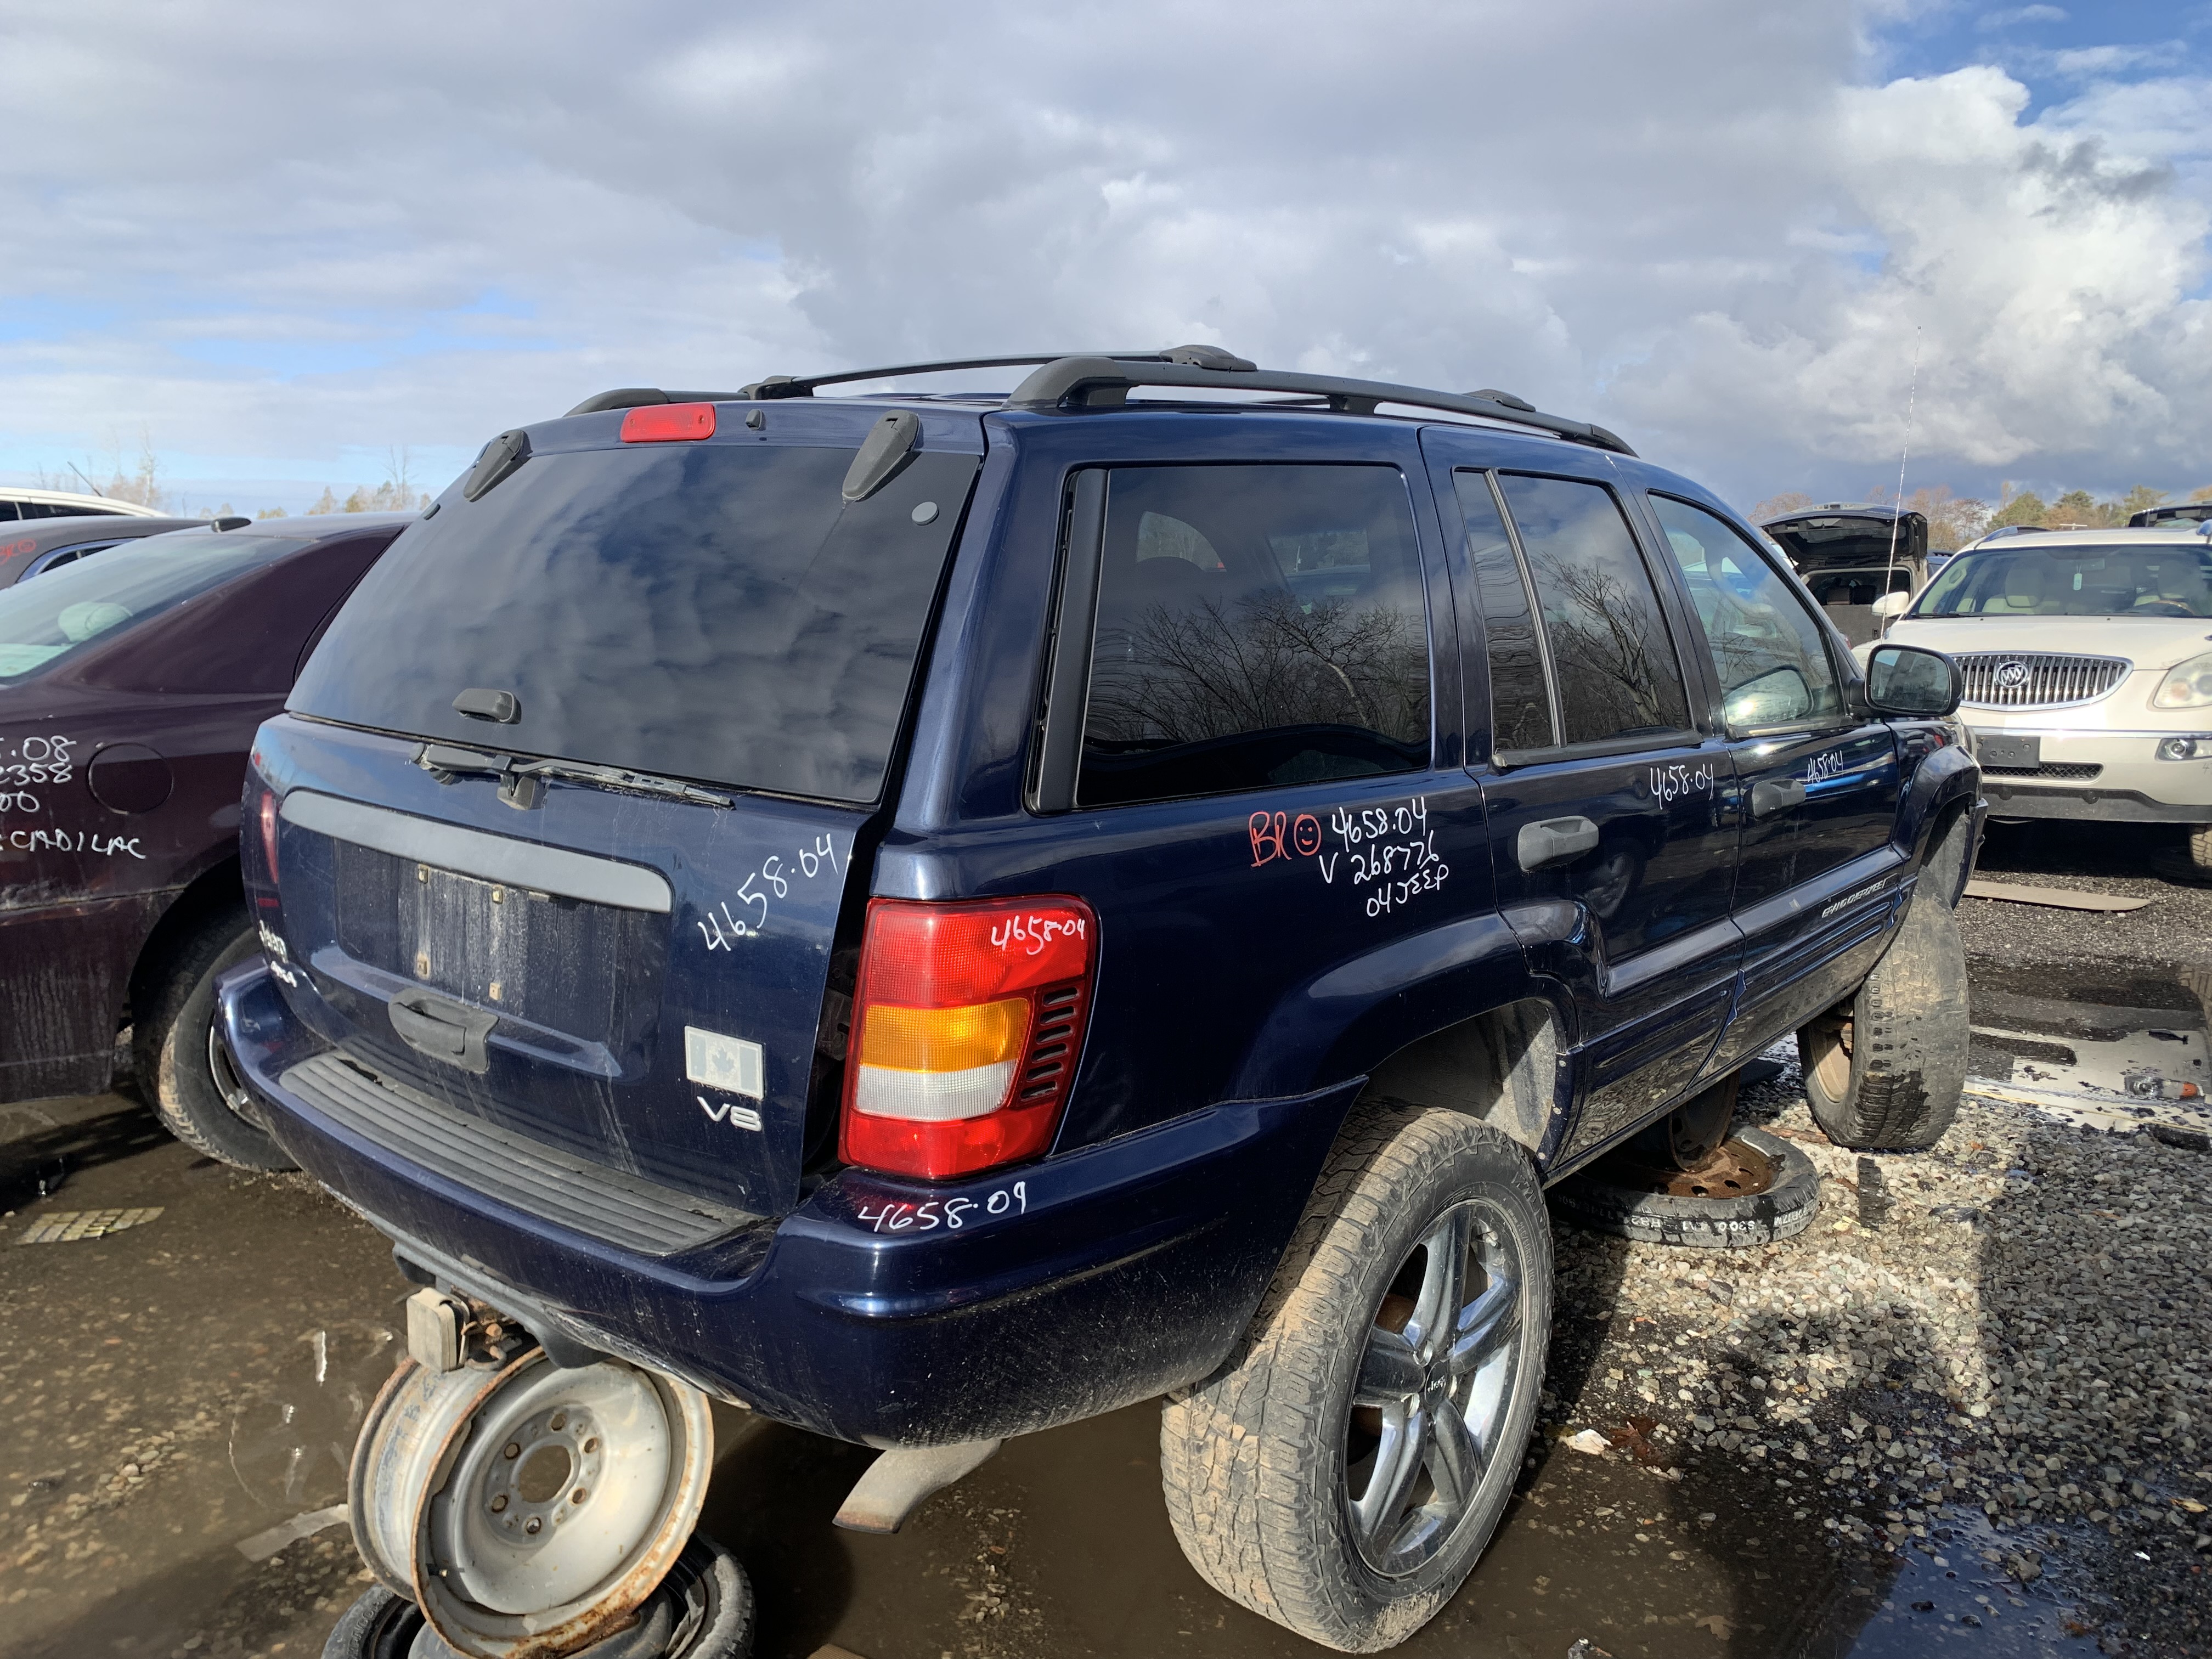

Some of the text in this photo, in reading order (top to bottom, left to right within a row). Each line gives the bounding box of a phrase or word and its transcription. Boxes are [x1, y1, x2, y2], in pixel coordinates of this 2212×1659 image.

[0, 735, 77, 763] .08
[1319, 851, 1339, 884] V
[1366, 864, 1449, 917] 04 JEEP
[696, 1096, 762, 1132] V8
